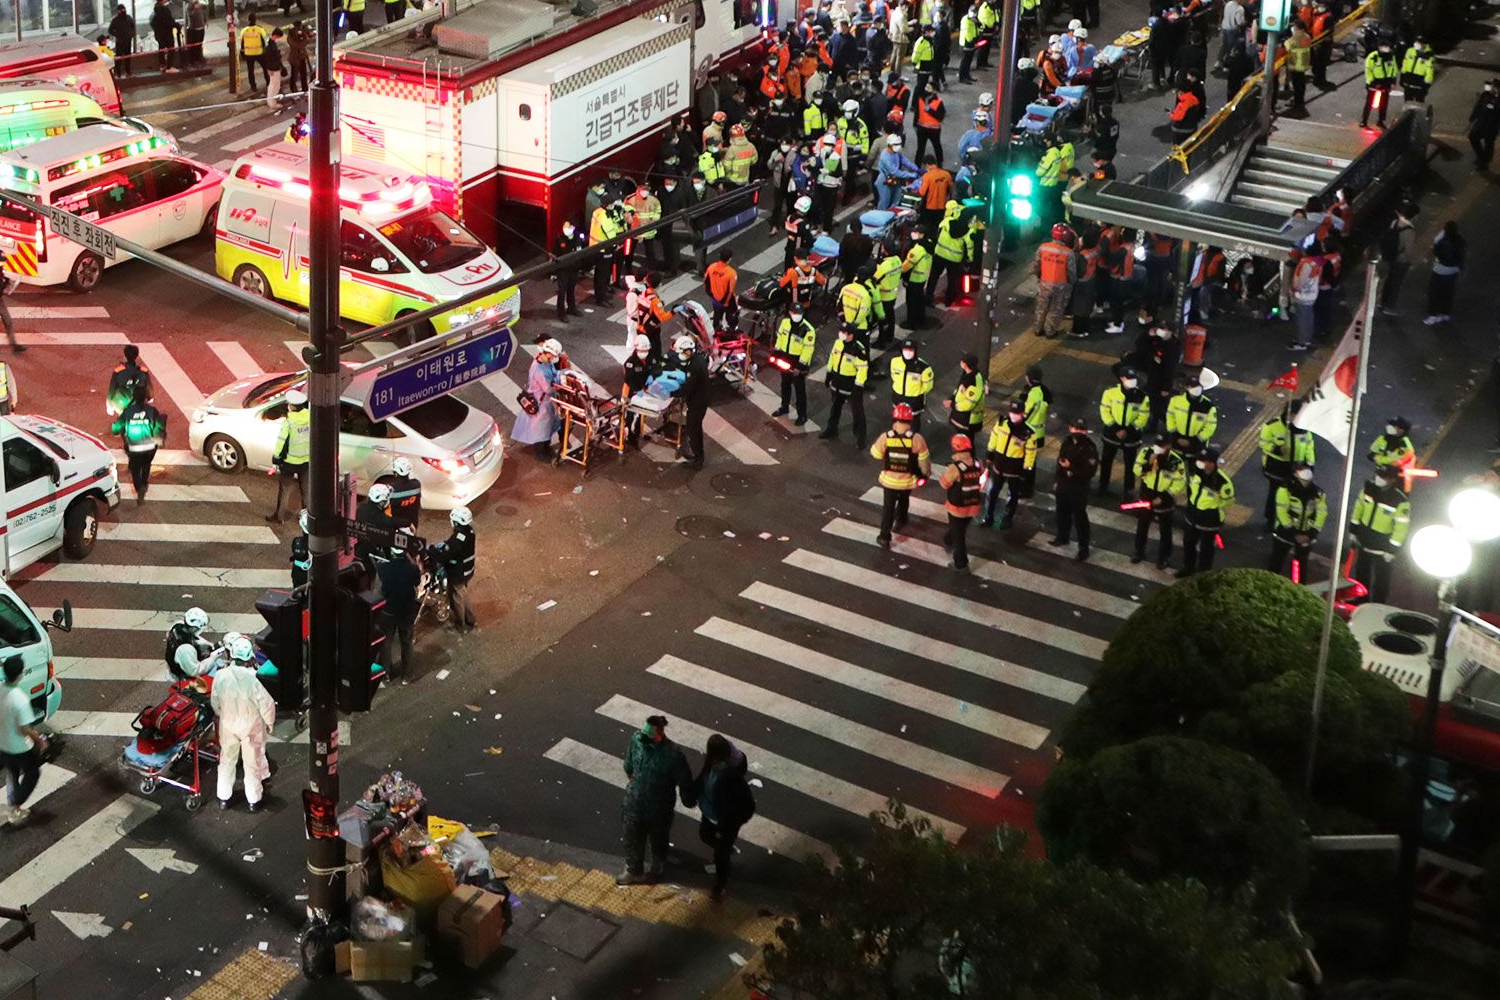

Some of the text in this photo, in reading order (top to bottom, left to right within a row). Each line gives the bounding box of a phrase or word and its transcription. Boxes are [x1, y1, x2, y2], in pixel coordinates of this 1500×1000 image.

[585, 83, 626, 114] 서울특별시
[585, 79, 680, 149] 긴급구조통제단
[228, 207, 257, 223] 119
[51, 210, 114, 257] 직진 후 좌회전
[416, 350, 468, 382] 이태원로
[489, 341, 508, 362] 177
[374, 386, 394, 408] 181
[397, 380, 448, 408] Itaewon-ro
